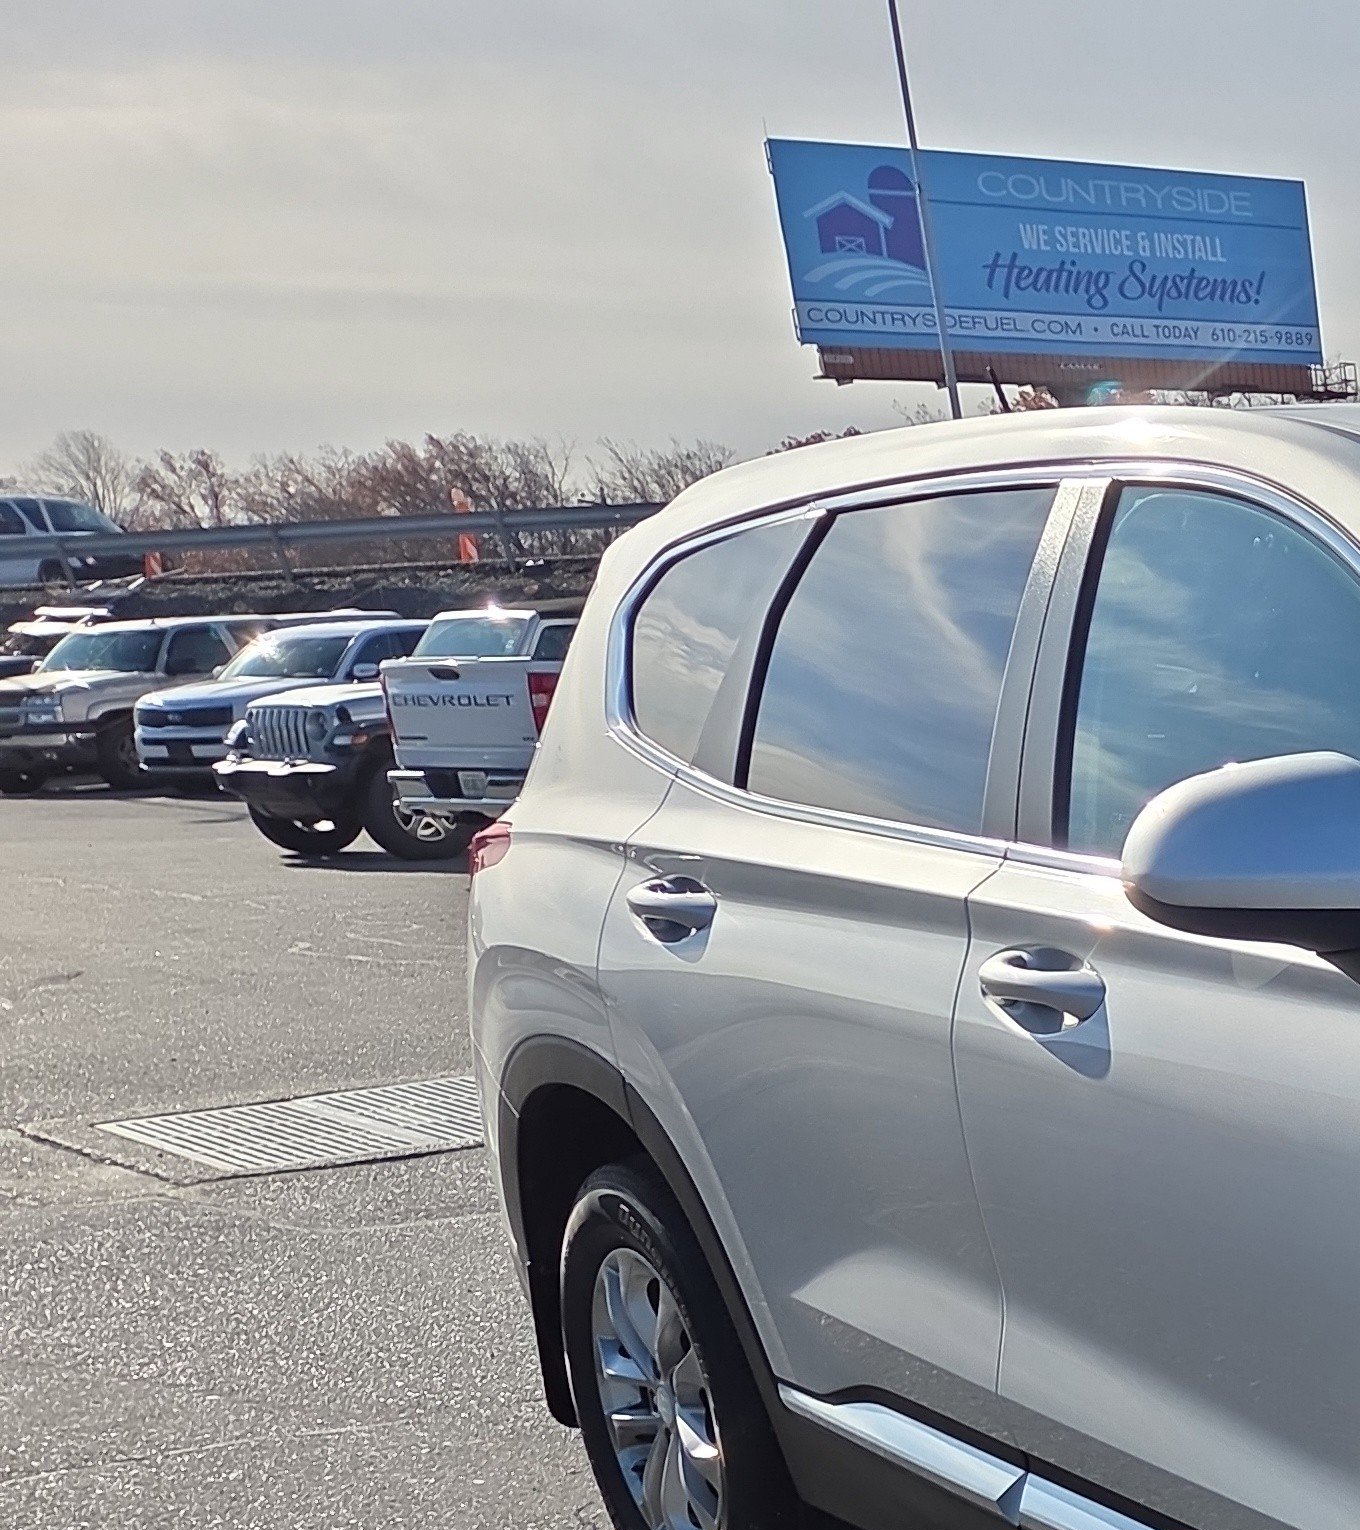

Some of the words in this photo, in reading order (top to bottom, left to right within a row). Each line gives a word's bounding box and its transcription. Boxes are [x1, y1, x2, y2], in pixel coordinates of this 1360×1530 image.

[976, 170, 1253, 217] COUNTRYSIDE
[1019, 222, 1051, 250] WE
[1055, 225, 1134, 256] SERVICE
[1137, 231, 1150, 257] &
[1154, 232, 1227, 262] INSTALL
[981, 251, 1117, 311] Heating
[1118, 259, 1266, 312] Systems!
[807, 307, 1083, 336] COUNTRYSDEFUEL.COM
[1110, 322, 1149, 339] CALL
[1153, 324, 1200, 341] TODAY
[1211, 327, 1313, 346] 610-215-9889
[391, 693, 514, 708] CHEVROLET
